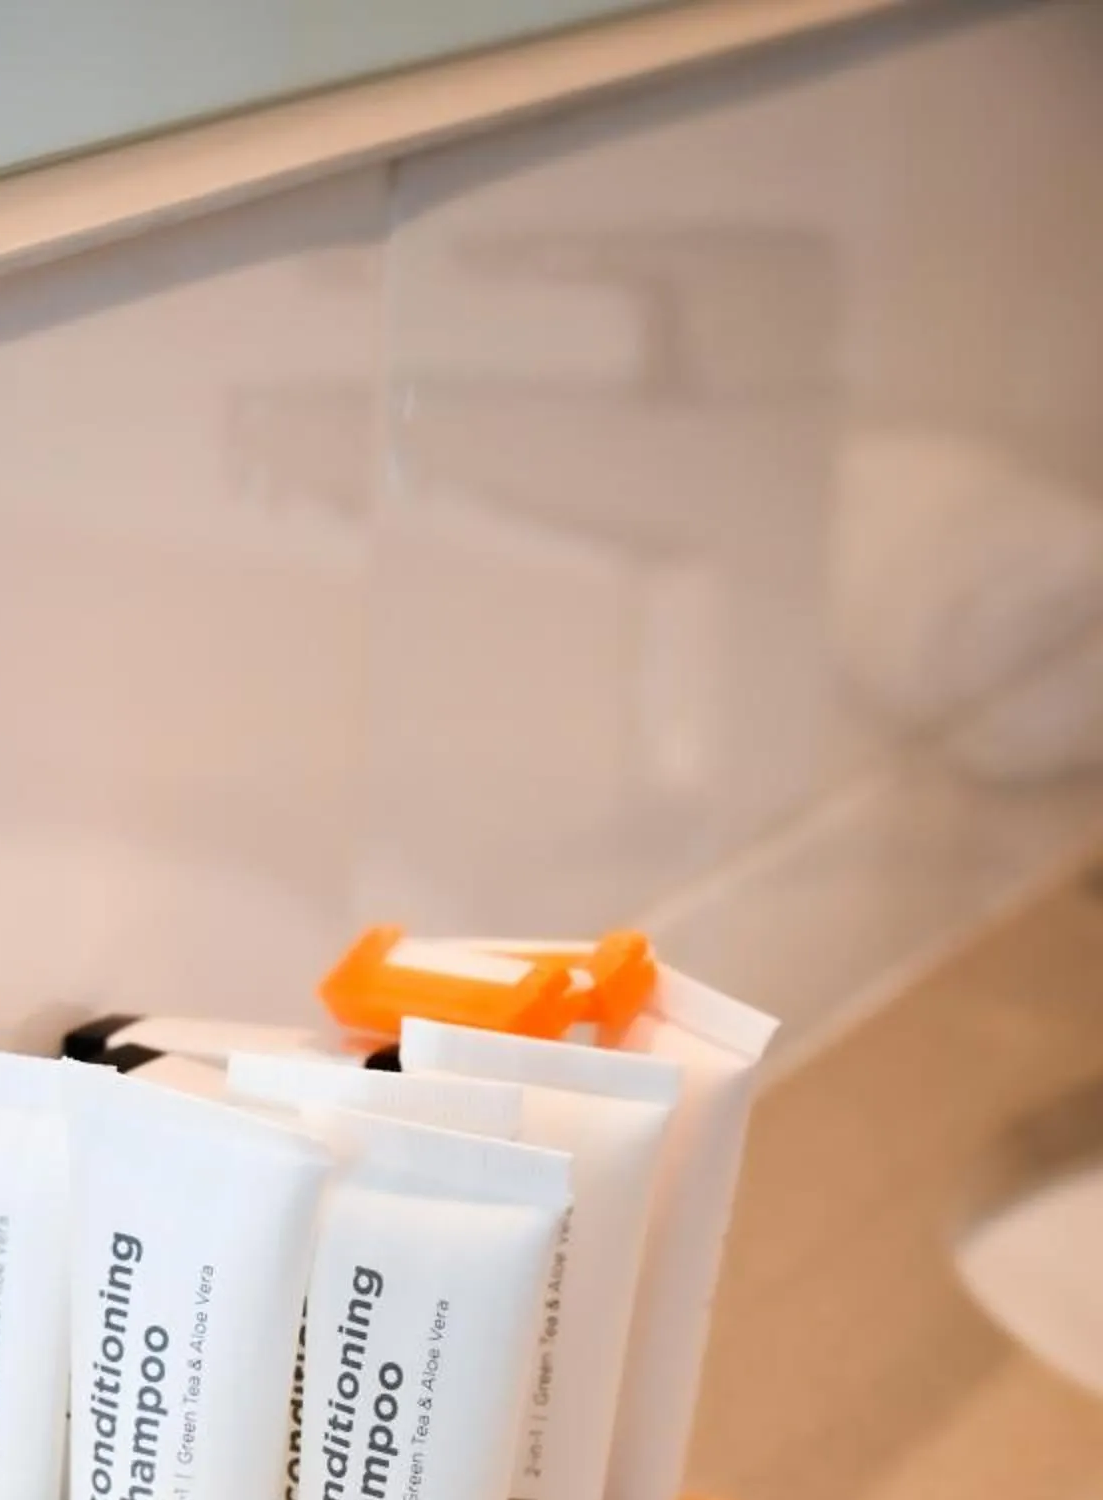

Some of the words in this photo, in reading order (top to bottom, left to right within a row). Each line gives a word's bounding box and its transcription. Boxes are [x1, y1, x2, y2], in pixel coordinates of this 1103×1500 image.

[194, 1265, 214, 1305] Vera
[547, 1251, 567, 1294] Aloe
[189, 1311, 208, 1354] Aloe
[428, 1300, 449, 1341] Vera
[538, 1315, 558, 1344] Tea
[187, 1359, 202, 1371] &
[421, 1348, 440, 1392] Aloe
[533, 1352, 553, 1406] Green
[182, 1375, 201, 1403] Tea
[417, 1398, 432, 1410] &
[177, 1410, 197, 1465] Green
[411, 1415, 429, 1446] Tea
